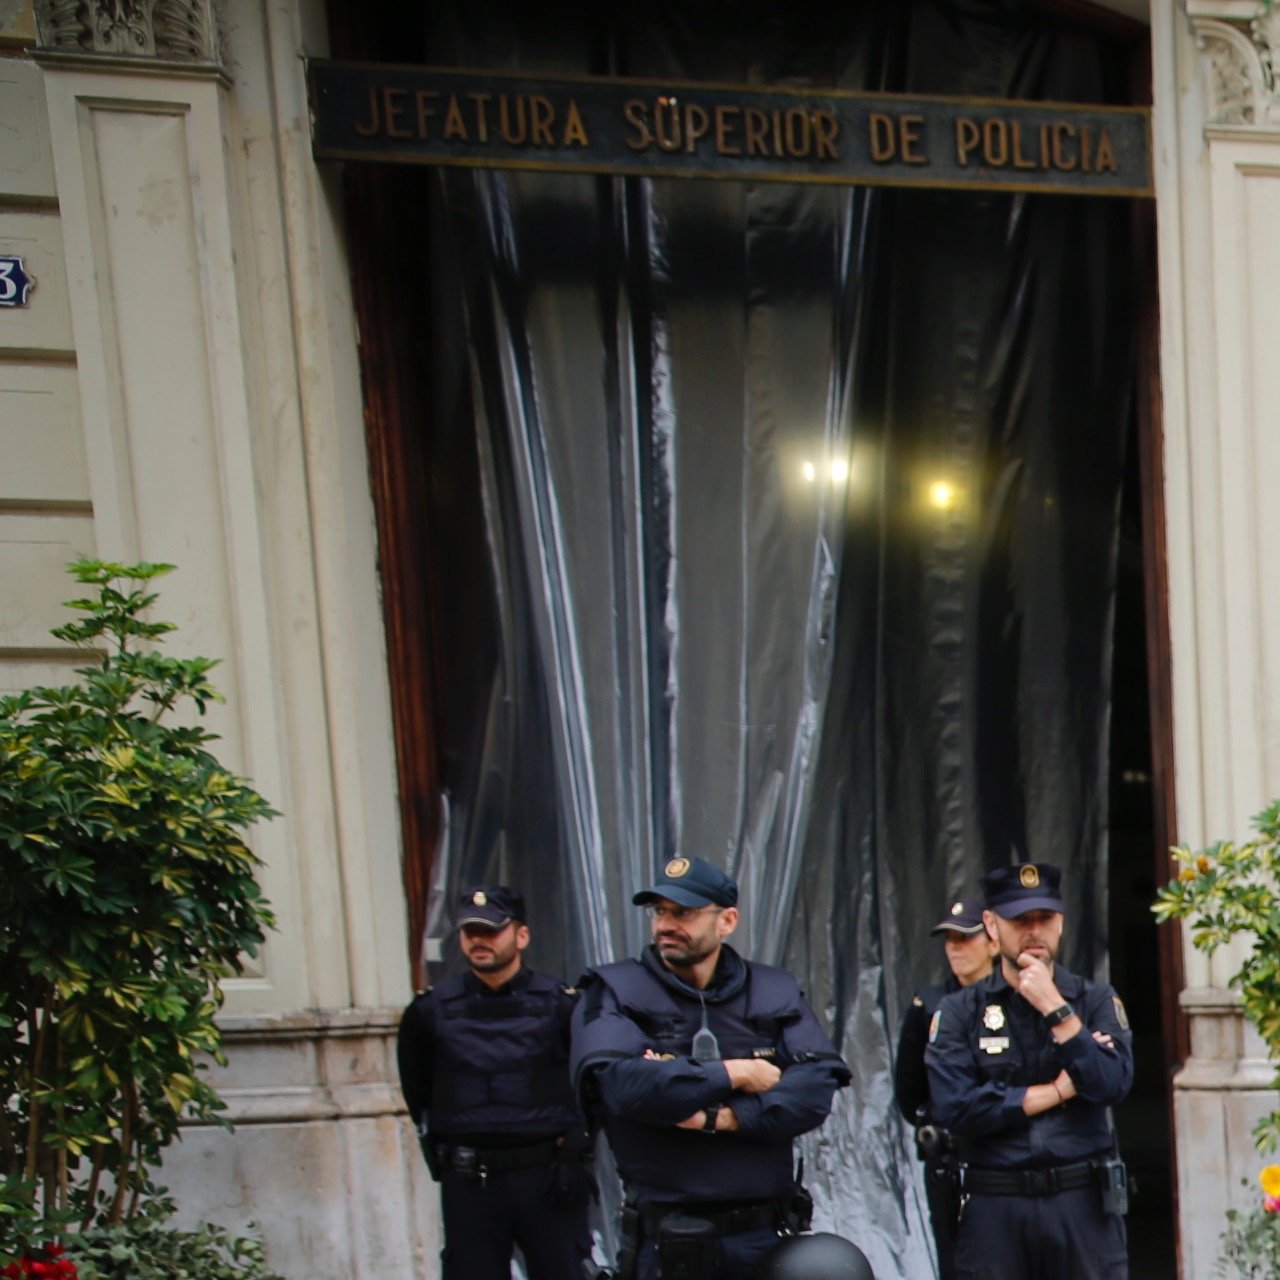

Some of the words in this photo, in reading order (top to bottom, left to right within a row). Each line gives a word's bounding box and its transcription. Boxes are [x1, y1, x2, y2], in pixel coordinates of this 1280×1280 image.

[355, 86, 589, 147] JEFATURA
[624, 97, 840, 160] SUPERIOR
[868, 112, 928, 163] DE
[956, 117, 1119, 173] POLICIA
